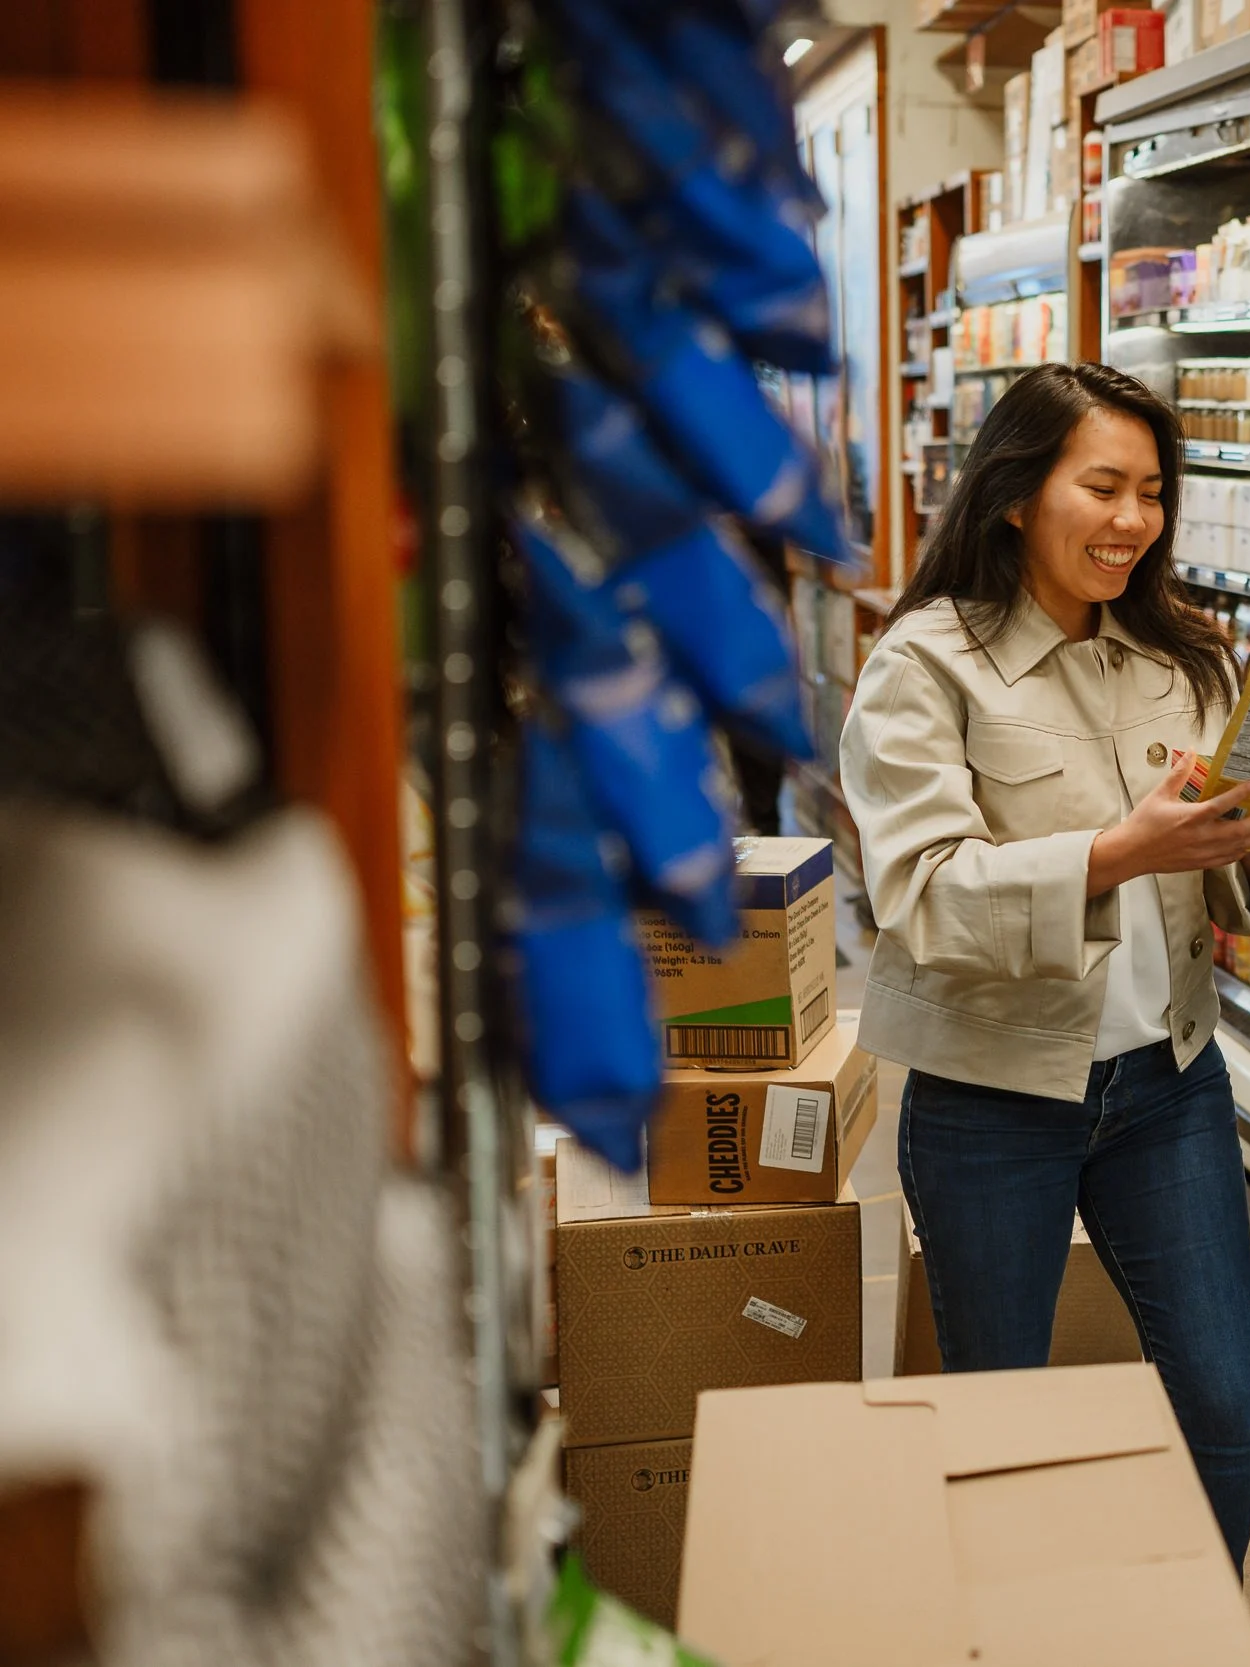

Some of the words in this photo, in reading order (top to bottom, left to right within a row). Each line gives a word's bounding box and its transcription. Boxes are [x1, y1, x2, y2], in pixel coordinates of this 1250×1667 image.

[752, 930, 781, 939] Onion
[665, 943, 694, 953] (160g)
[652, 955, 688, 966] Weight:
[690, 956, 705, 965] 4.3
[707, 955, 722, 965] lbs
[654, 969, 684, 978] 9657K
[705, 1092, 744, 1194] CHEDDIES
[649, 1247, 686, 1263] THE
[690, 1243, 740, 1261] DAILY
[743, 1239, 801, 1257] CRAVE
[655, 1470, 692, 1486] THE
